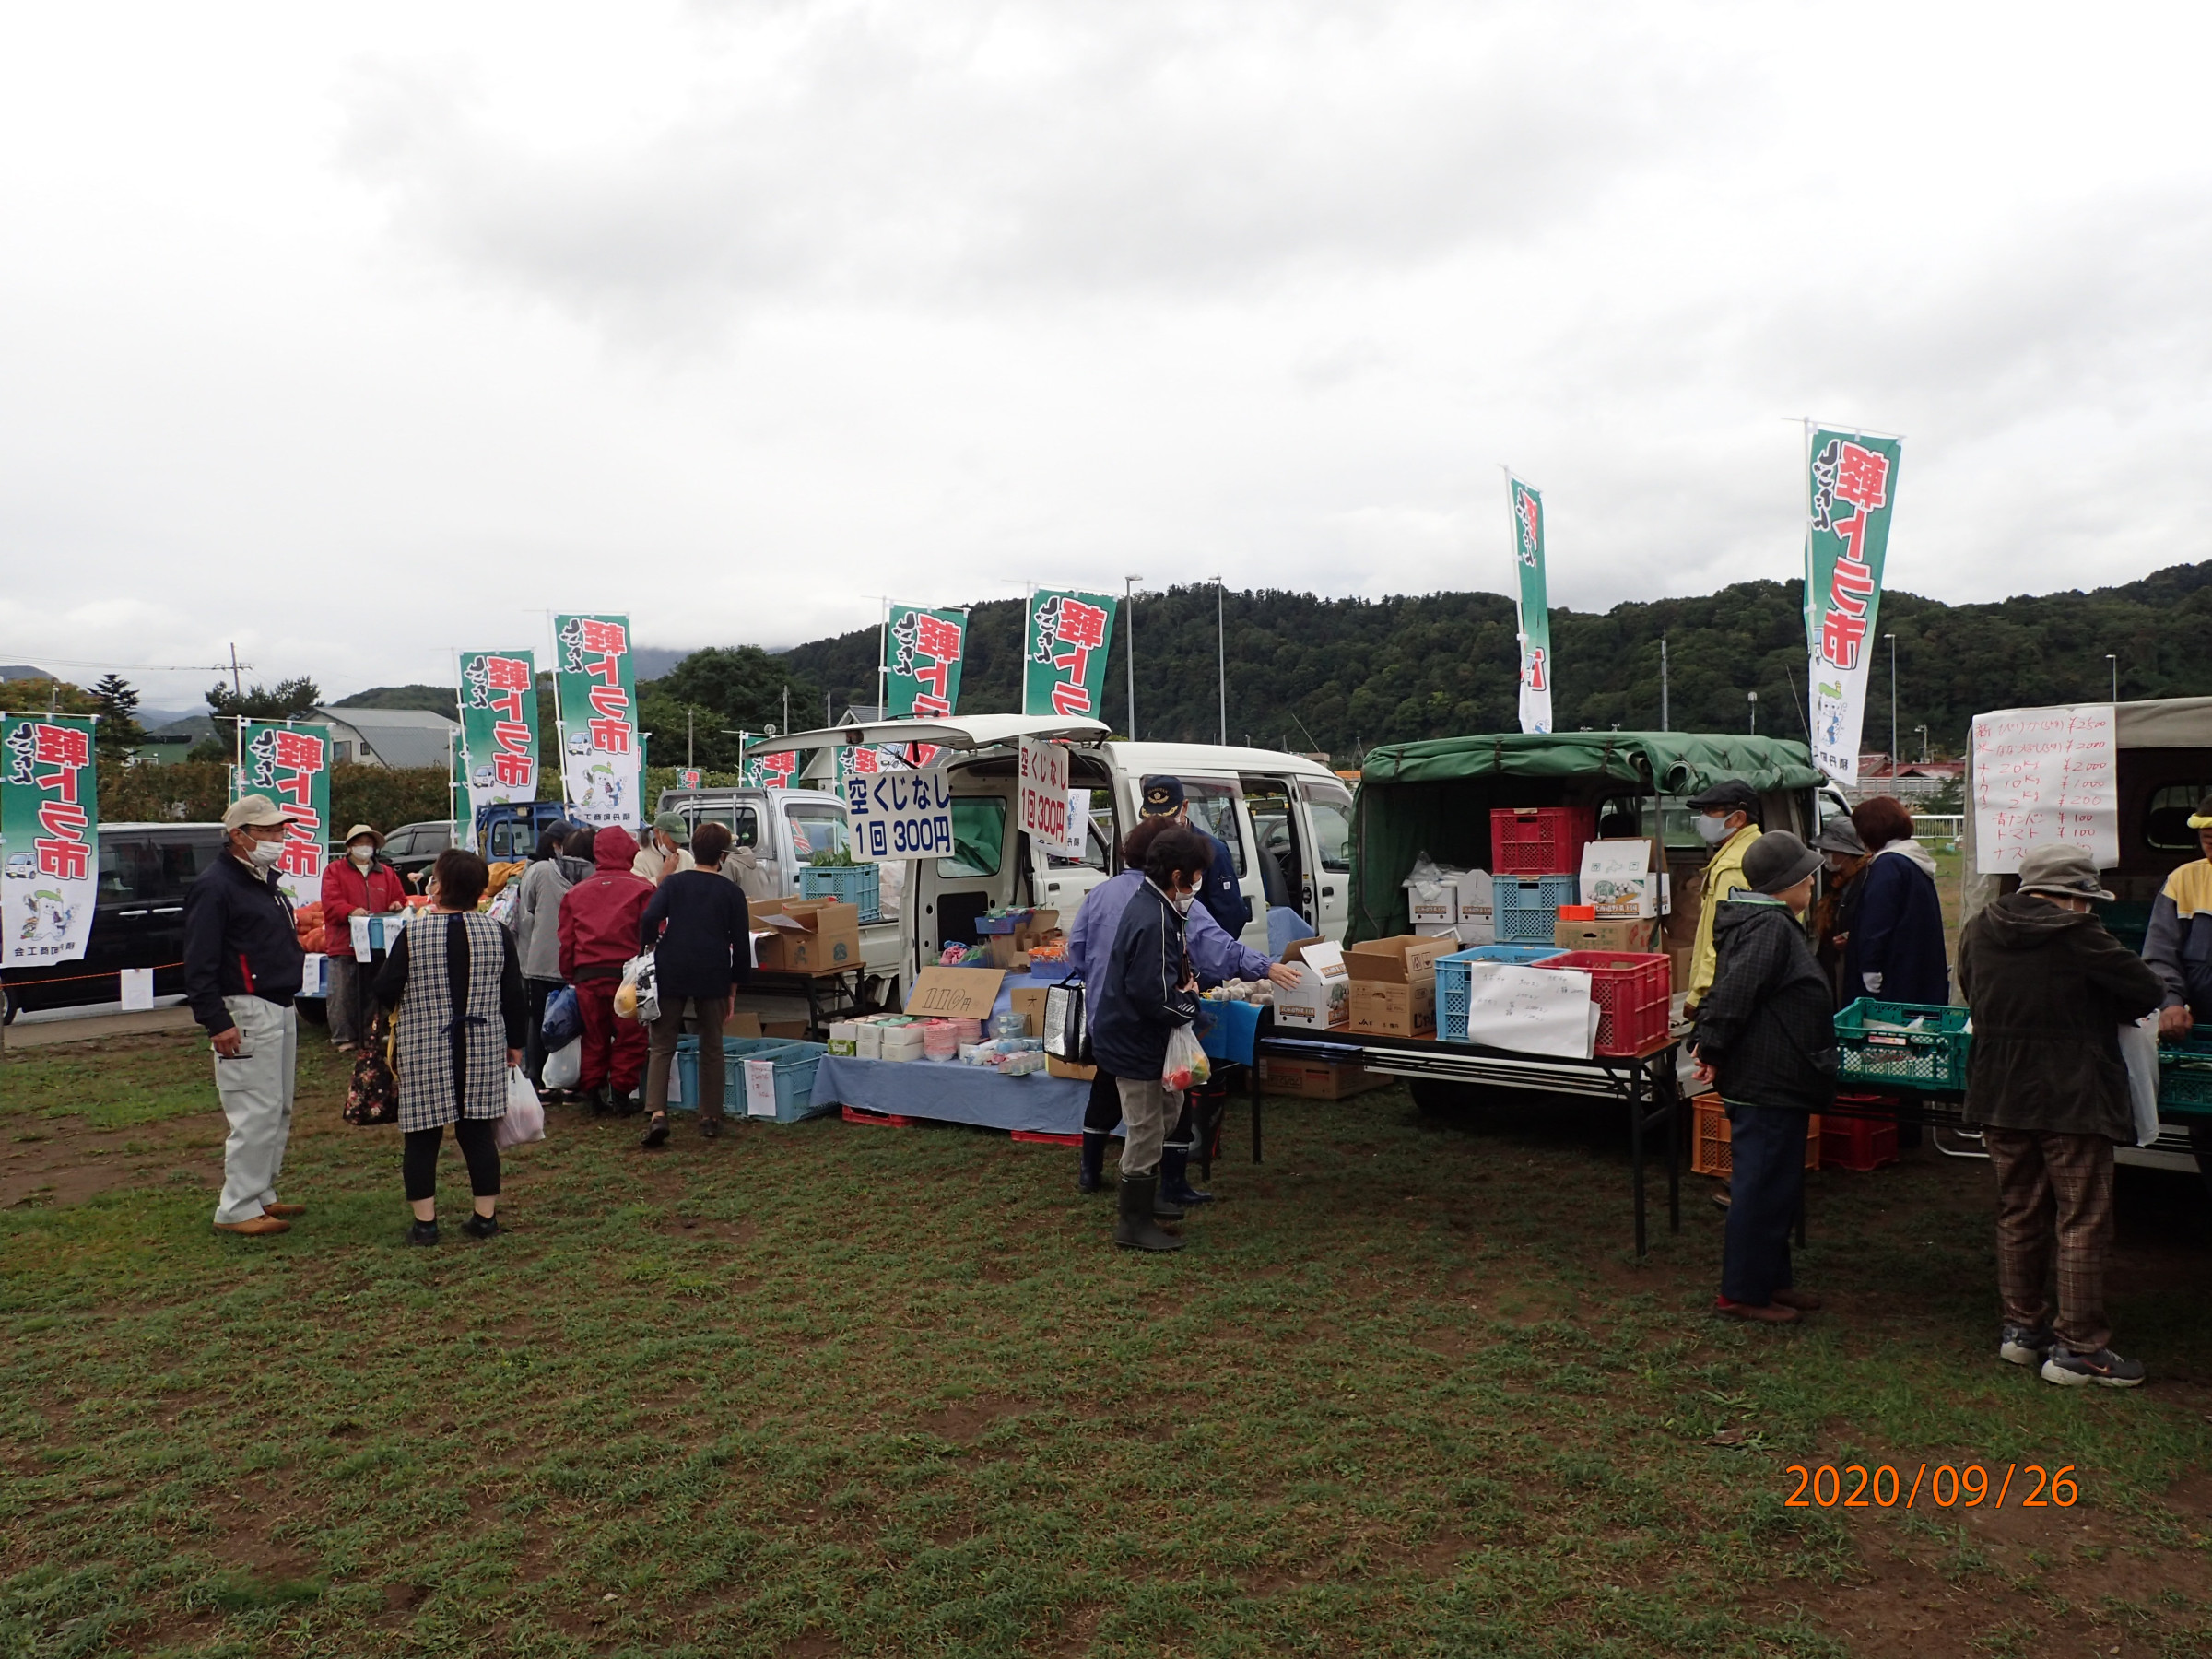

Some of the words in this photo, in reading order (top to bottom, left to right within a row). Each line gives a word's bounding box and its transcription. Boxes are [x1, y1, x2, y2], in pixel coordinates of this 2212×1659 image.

[1021, 746, 1066, 791] 空くじなし
[848, 773, 950, 815] 空くじなし
[1998, 828, 2039, 840] トマト
[1994, 847, 2028, 860] ナス
